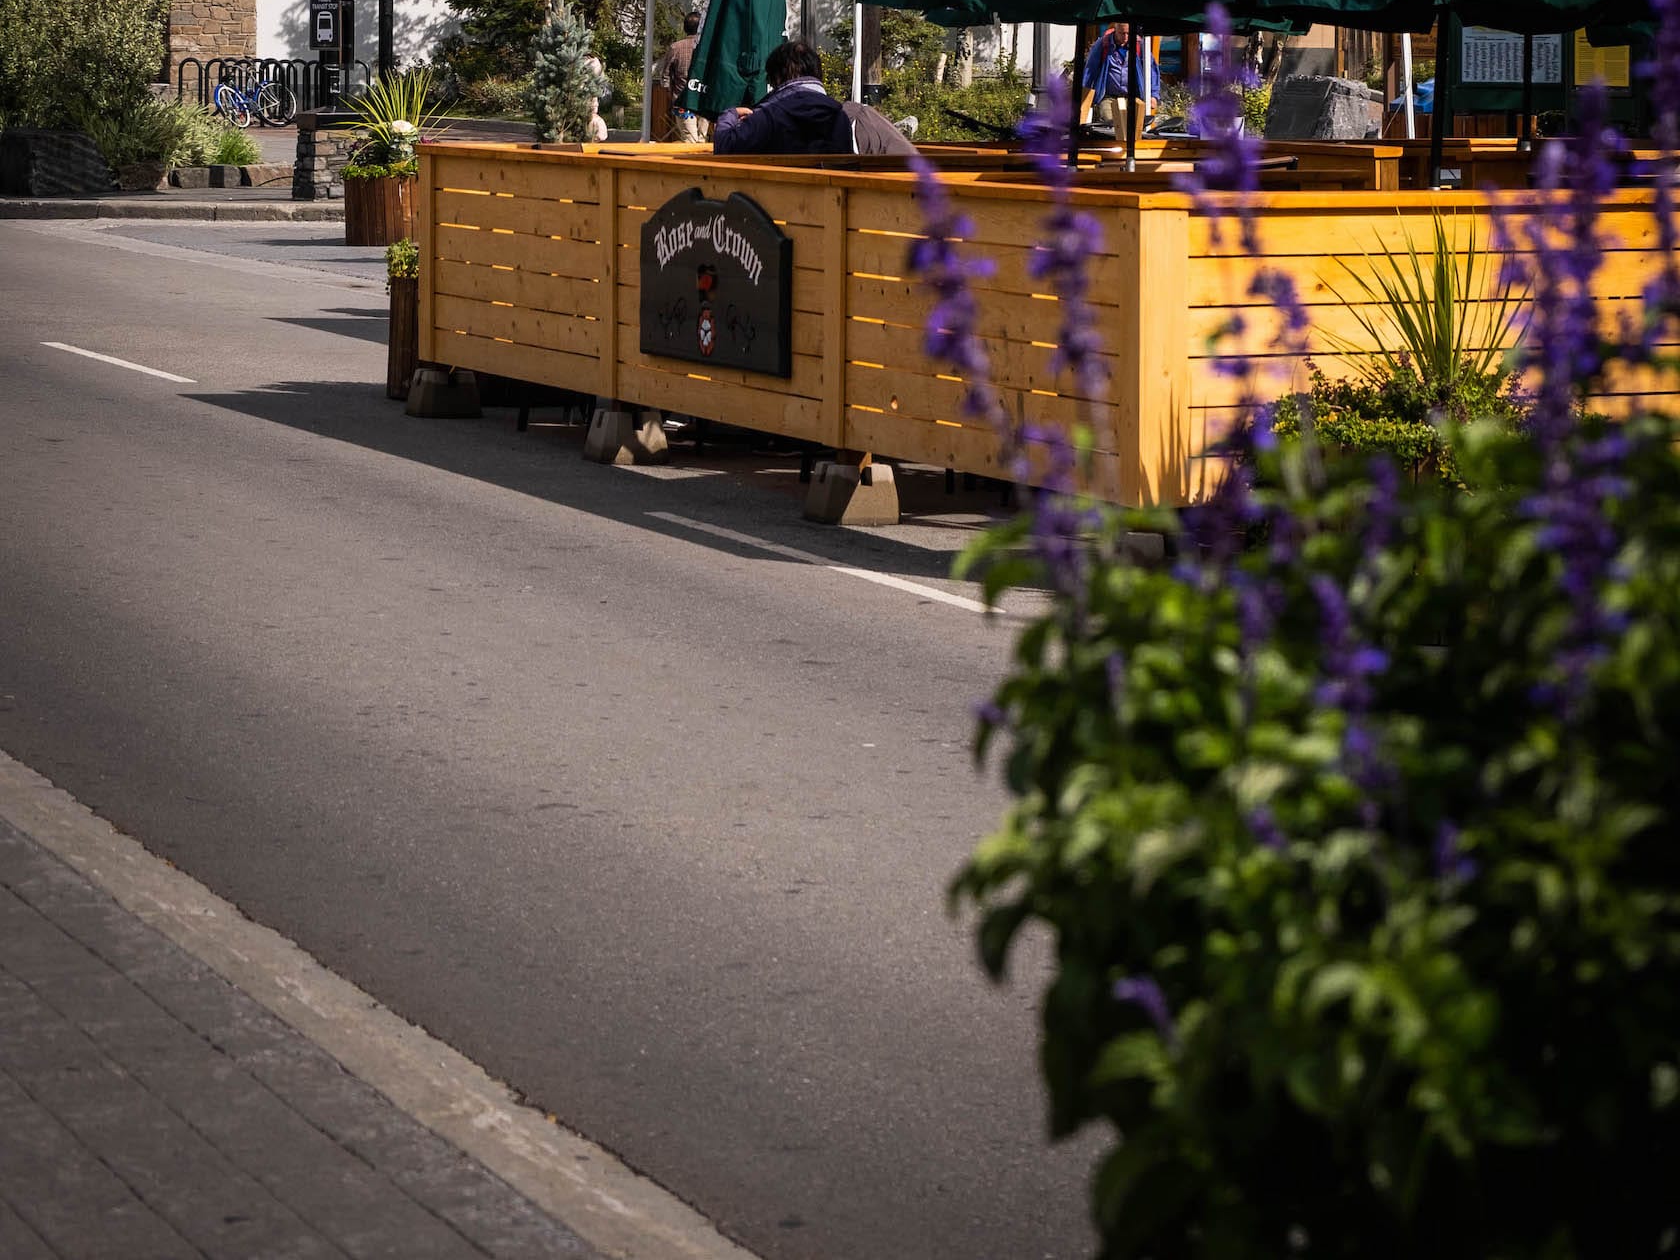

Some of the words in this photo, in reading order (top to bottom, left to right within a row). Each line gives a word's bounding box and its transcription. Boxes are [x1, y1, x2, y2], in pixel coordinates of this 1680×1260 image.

[654, 220, 694, 271] Rose
[694, 216, 712, 240] and
[712, 214, 764, 286] Crown
